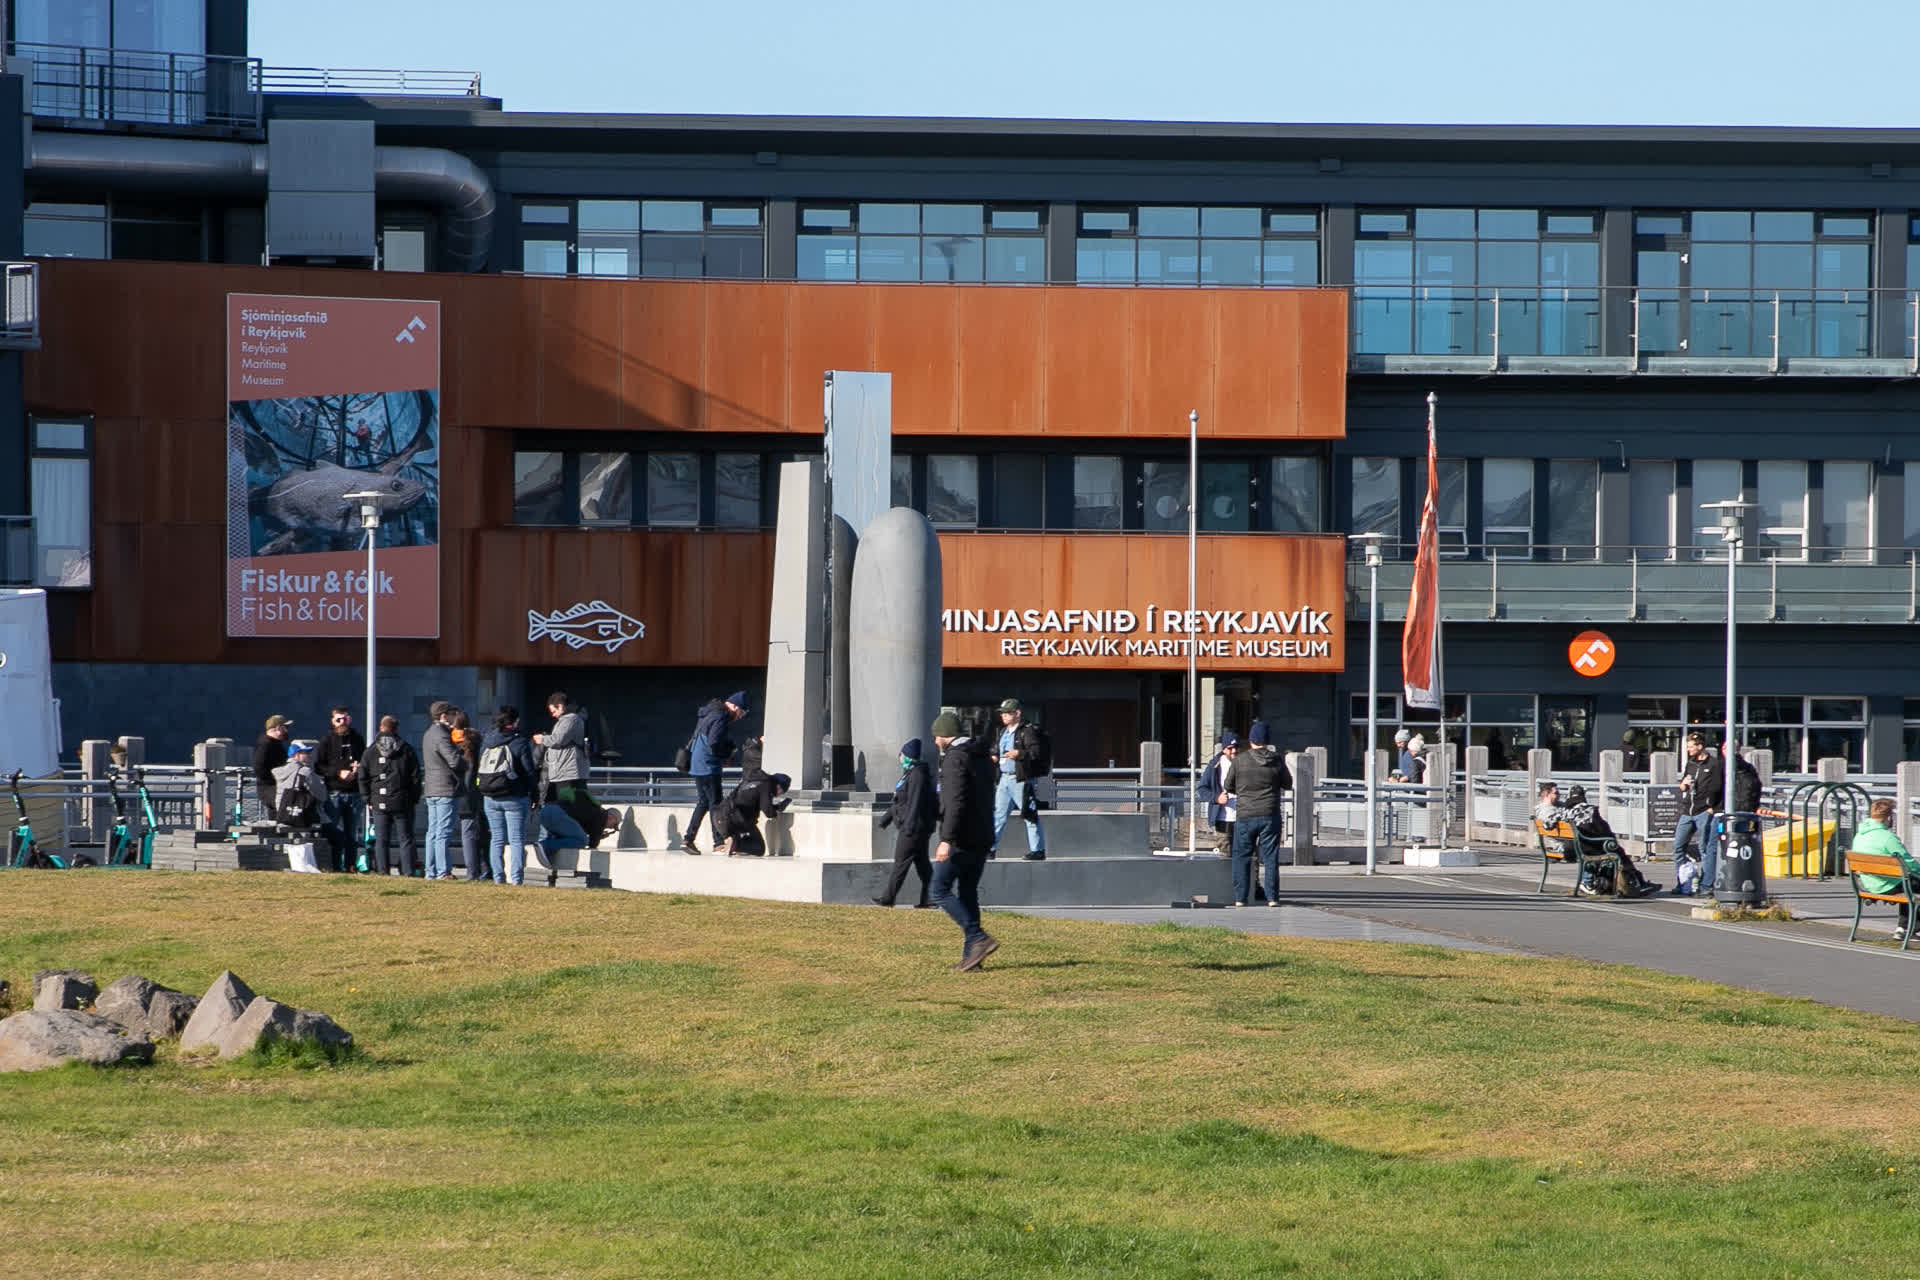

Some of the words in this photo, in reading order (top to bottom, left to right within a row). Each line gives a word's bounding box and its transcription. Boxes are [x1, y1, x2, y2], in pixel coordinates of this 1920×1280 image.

[241, 358, 287, 370] Maritime
[241, 374, 285, 385] Museum
[1146, 604, 1154, 633] Í
[1163, 605, 1329, 633] REYKJAVÍK
[1001, 636, 1119, 655] REYKJAVÍK
[1125, 639, 1229, 656] MARITIME
[1236, 640, 1328, 656] MUSEUM
